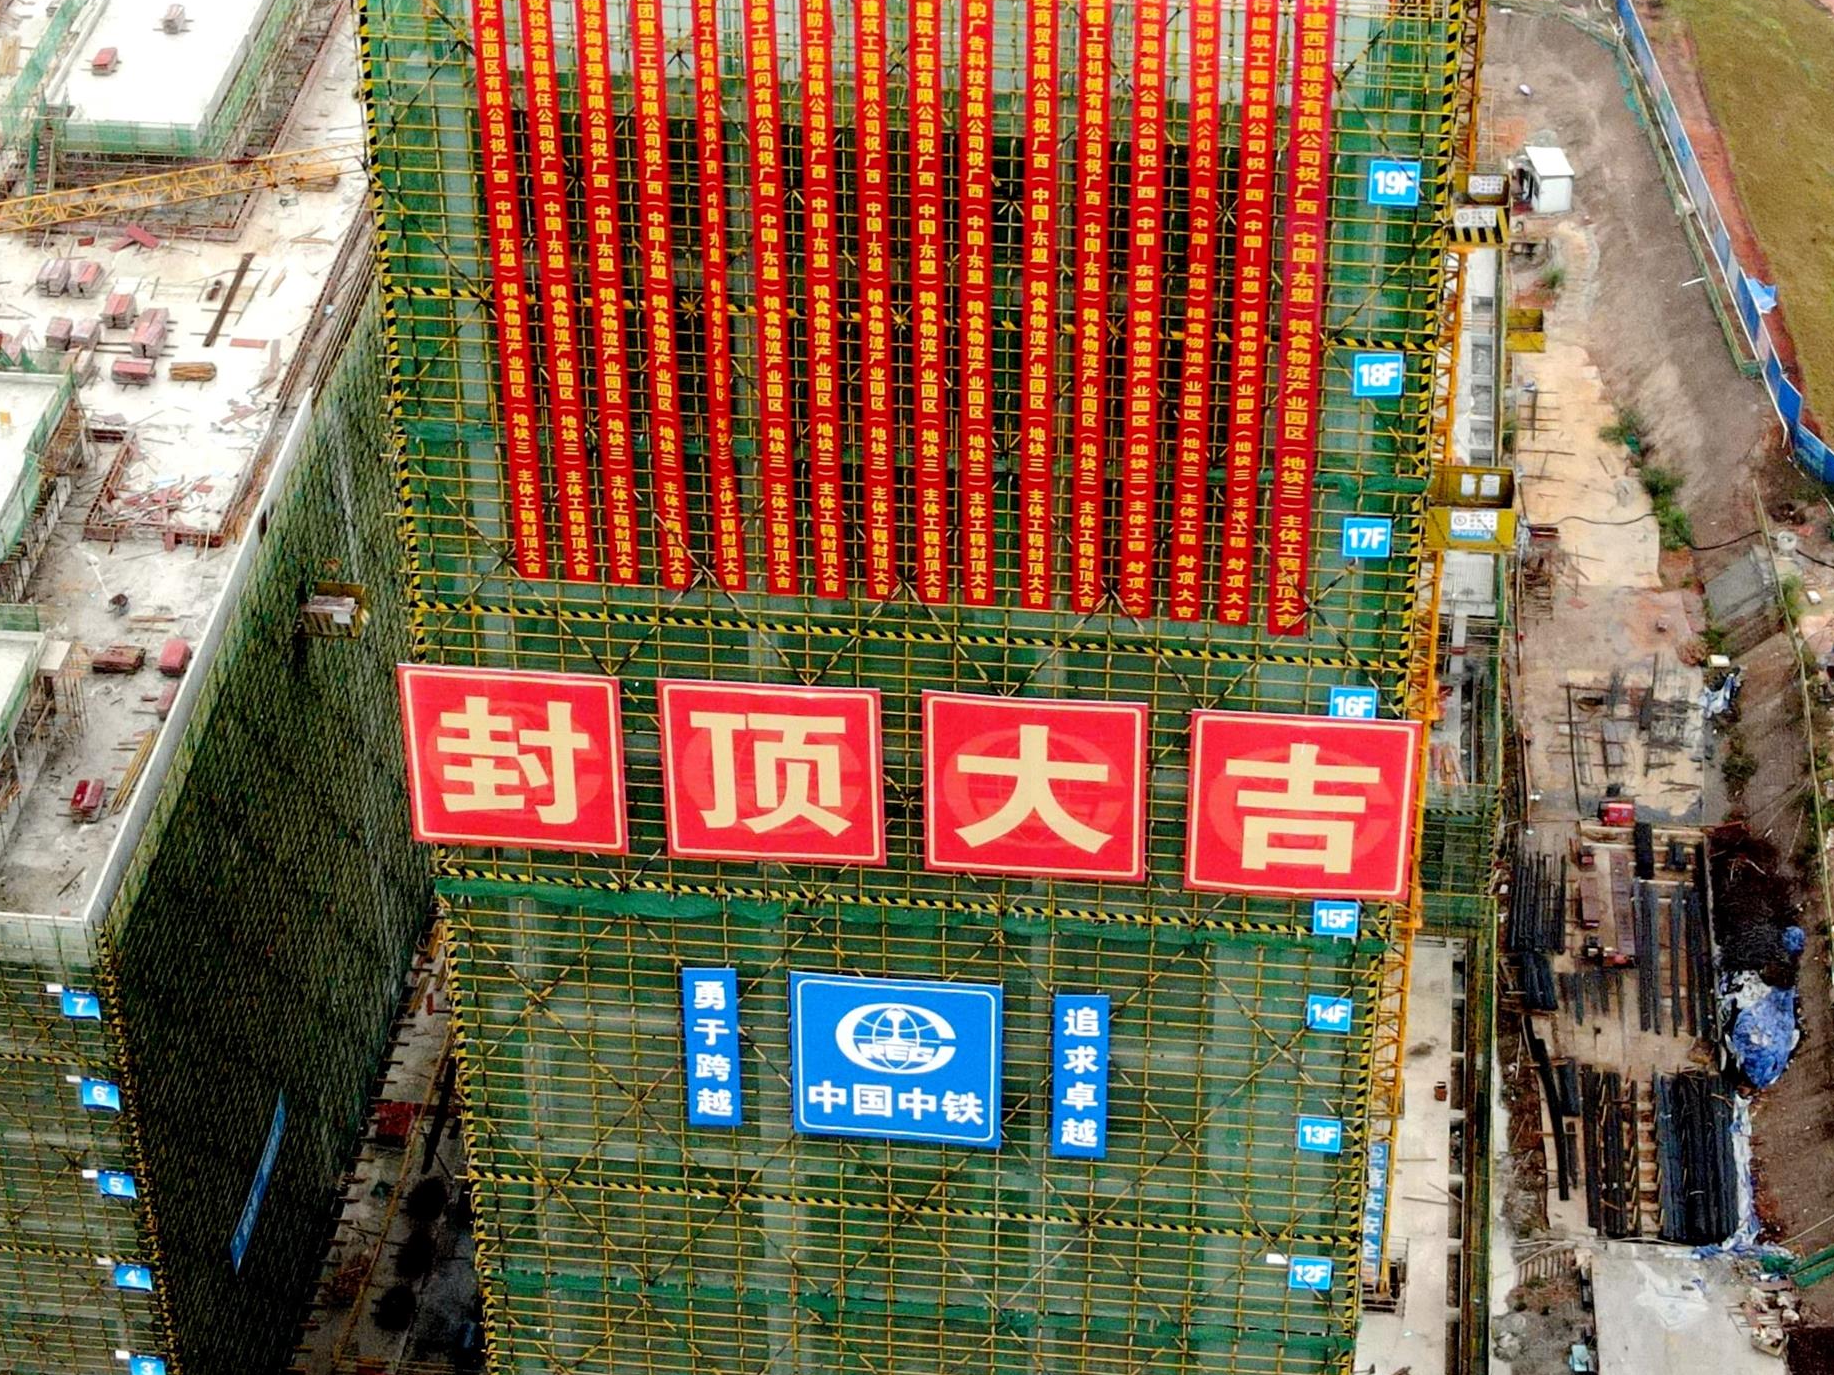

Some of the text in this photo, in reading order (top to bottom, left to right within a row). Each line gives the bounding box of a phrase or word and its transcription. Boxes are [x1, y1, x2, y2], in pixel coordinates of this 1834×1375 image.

[1373, 170, 1417, 198] 19F
[1357, 362, 1400, 388] 18F
[1345, 526, 1387, 551] 17F
[1334, 694, 1373, 718] 16F
[438, 697, 1381, 872] 封顶大吉
[1316, 907, 1355, 931] 15F
[1309, 1002, 1349, 1025] 14F
[692, 980, 734, 1118] 勇于跨越
[1062, 1007, 1100, 1150] 追求卓越
[808, 1079, 985, 1127] 中国中铁
[1301, 1123, 1339, 1145] 13F
[1292, 1263, 1330, 1282] 12F
